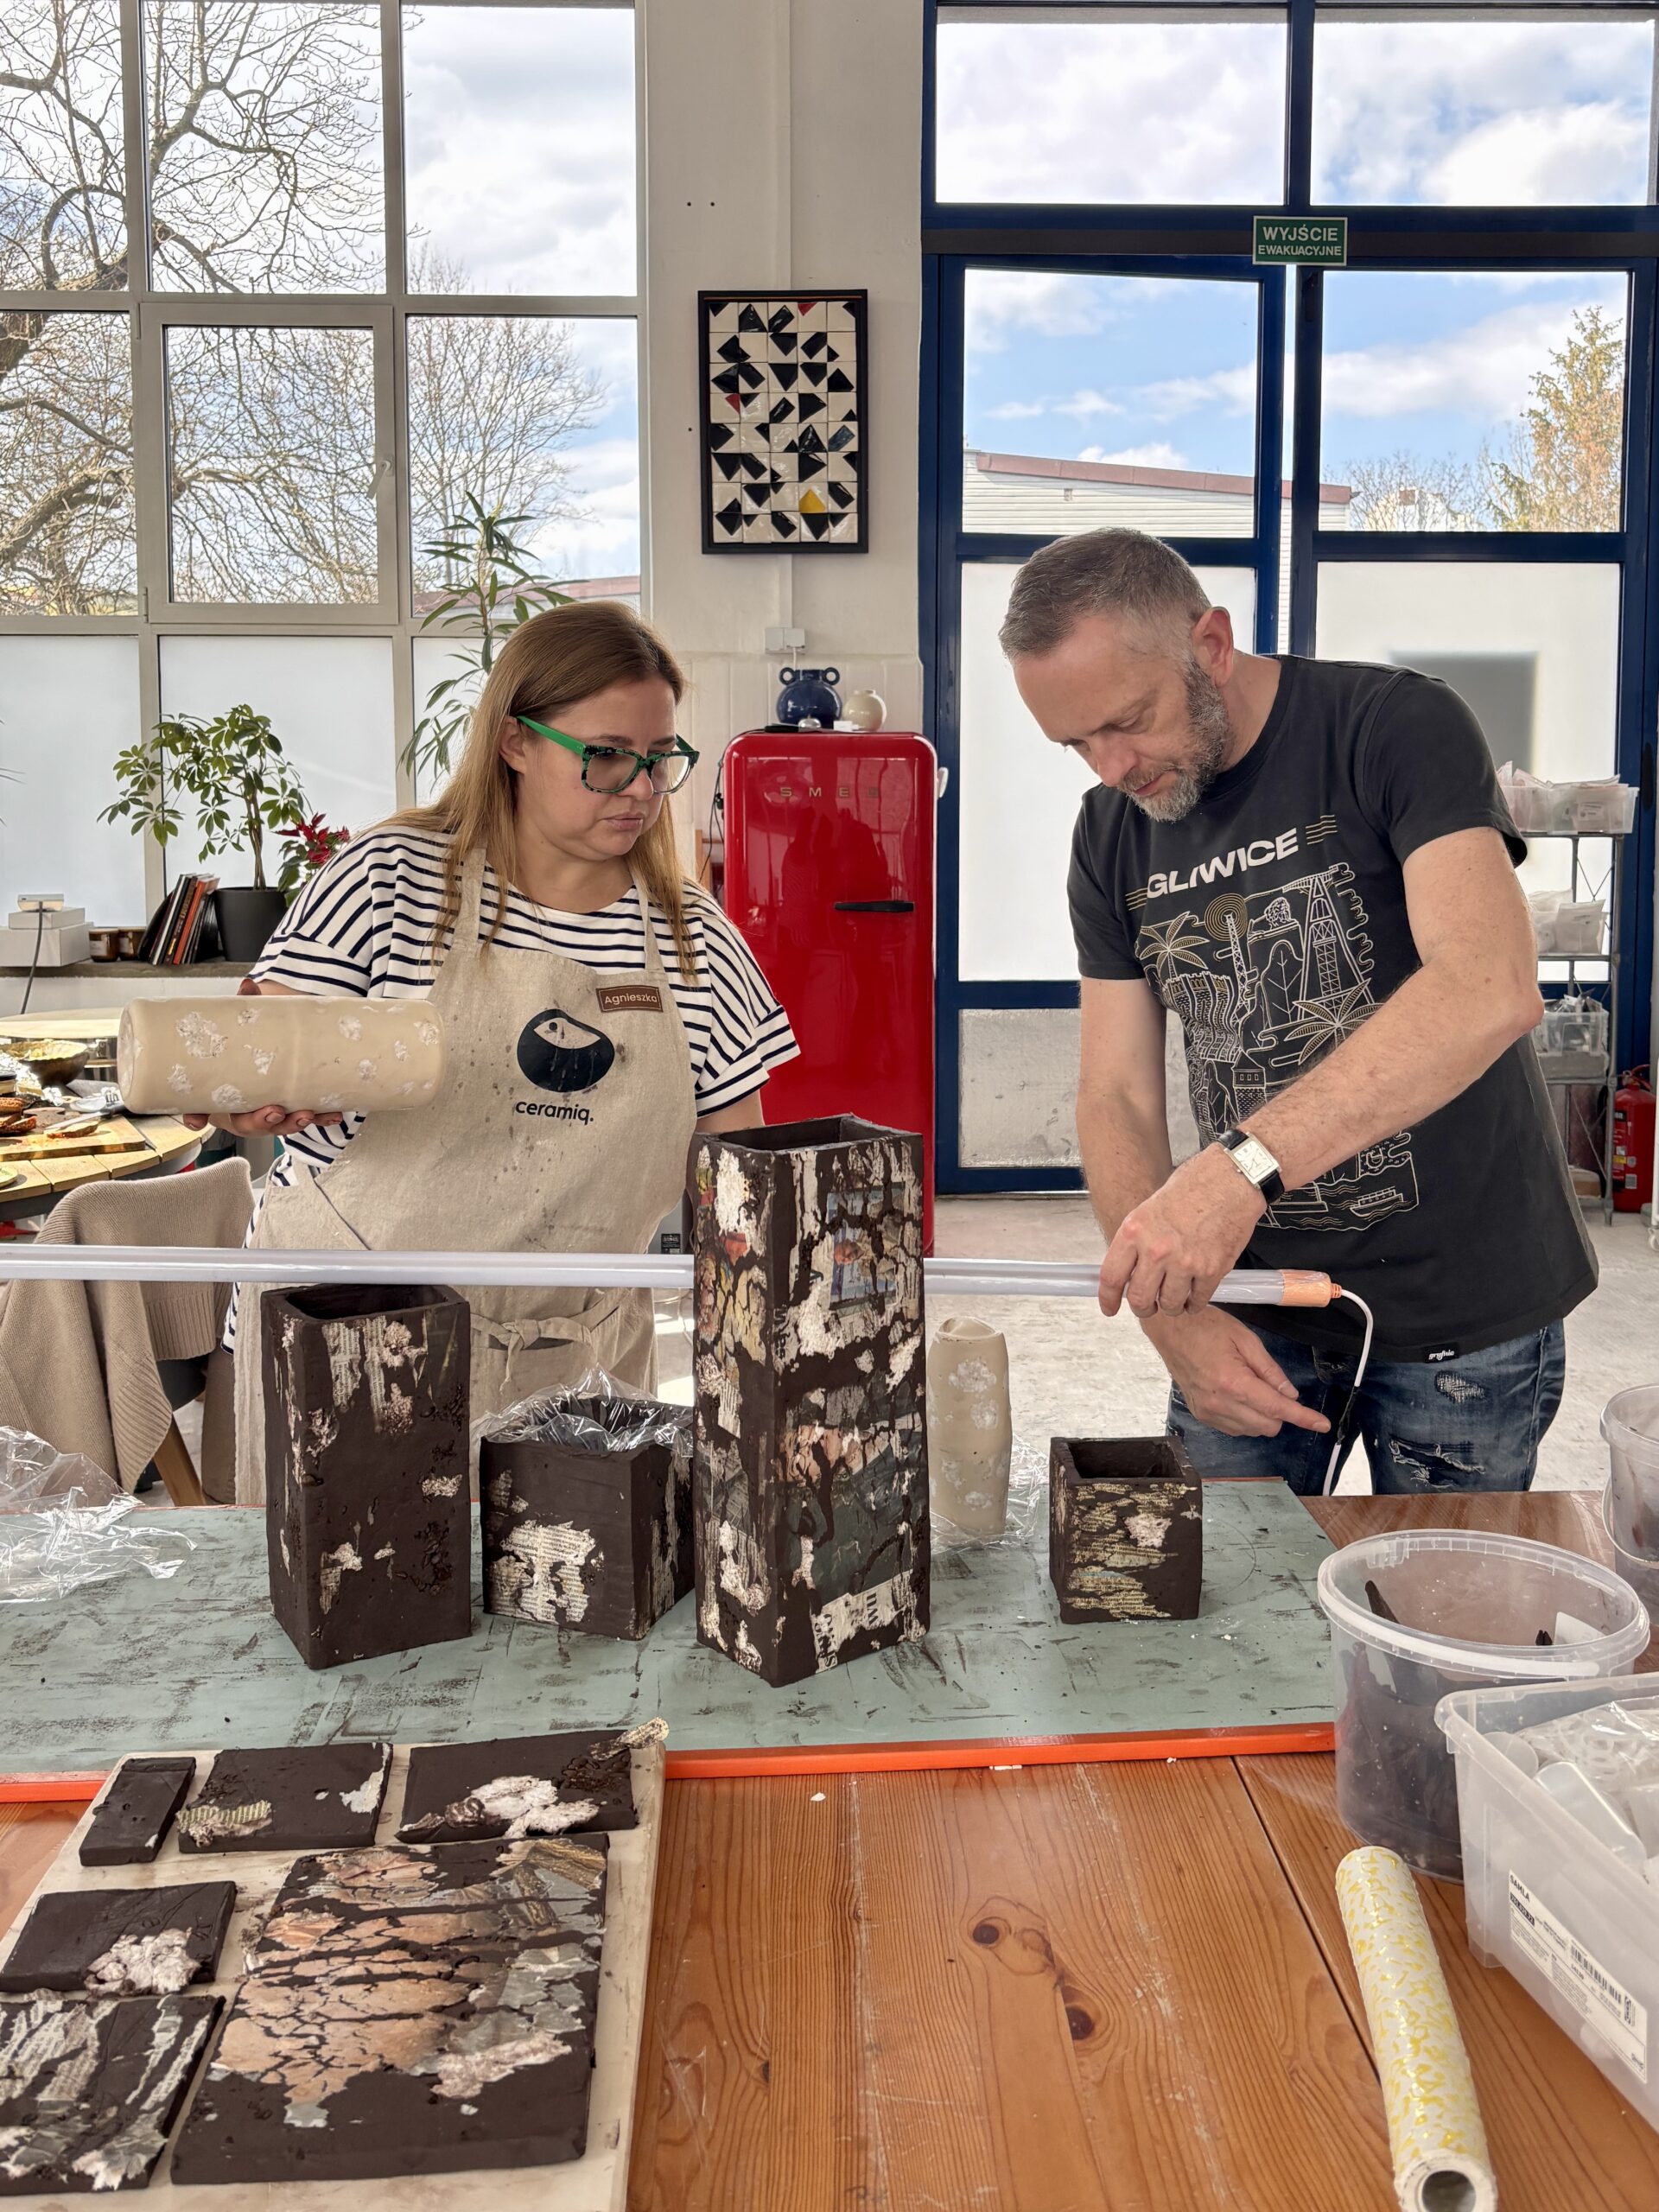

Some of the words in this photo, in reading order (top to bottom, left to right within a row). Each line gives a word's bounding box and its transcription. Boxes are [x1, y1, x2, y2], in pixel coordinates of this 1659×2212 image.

[1262, 224, 1338, 242] WYJŚCIE
[1257, 245, 1342, 257] EWAKUACYJNE
[779, 786, 880, 798] SME
[1146, 827, 1300, 899] GLIWICE
[604, 993, 658, 1006] Agnieszka
[515, 1100, 594, 1125] ceramiq.
[1510, 1874, 1530, 1903] SAMLA
